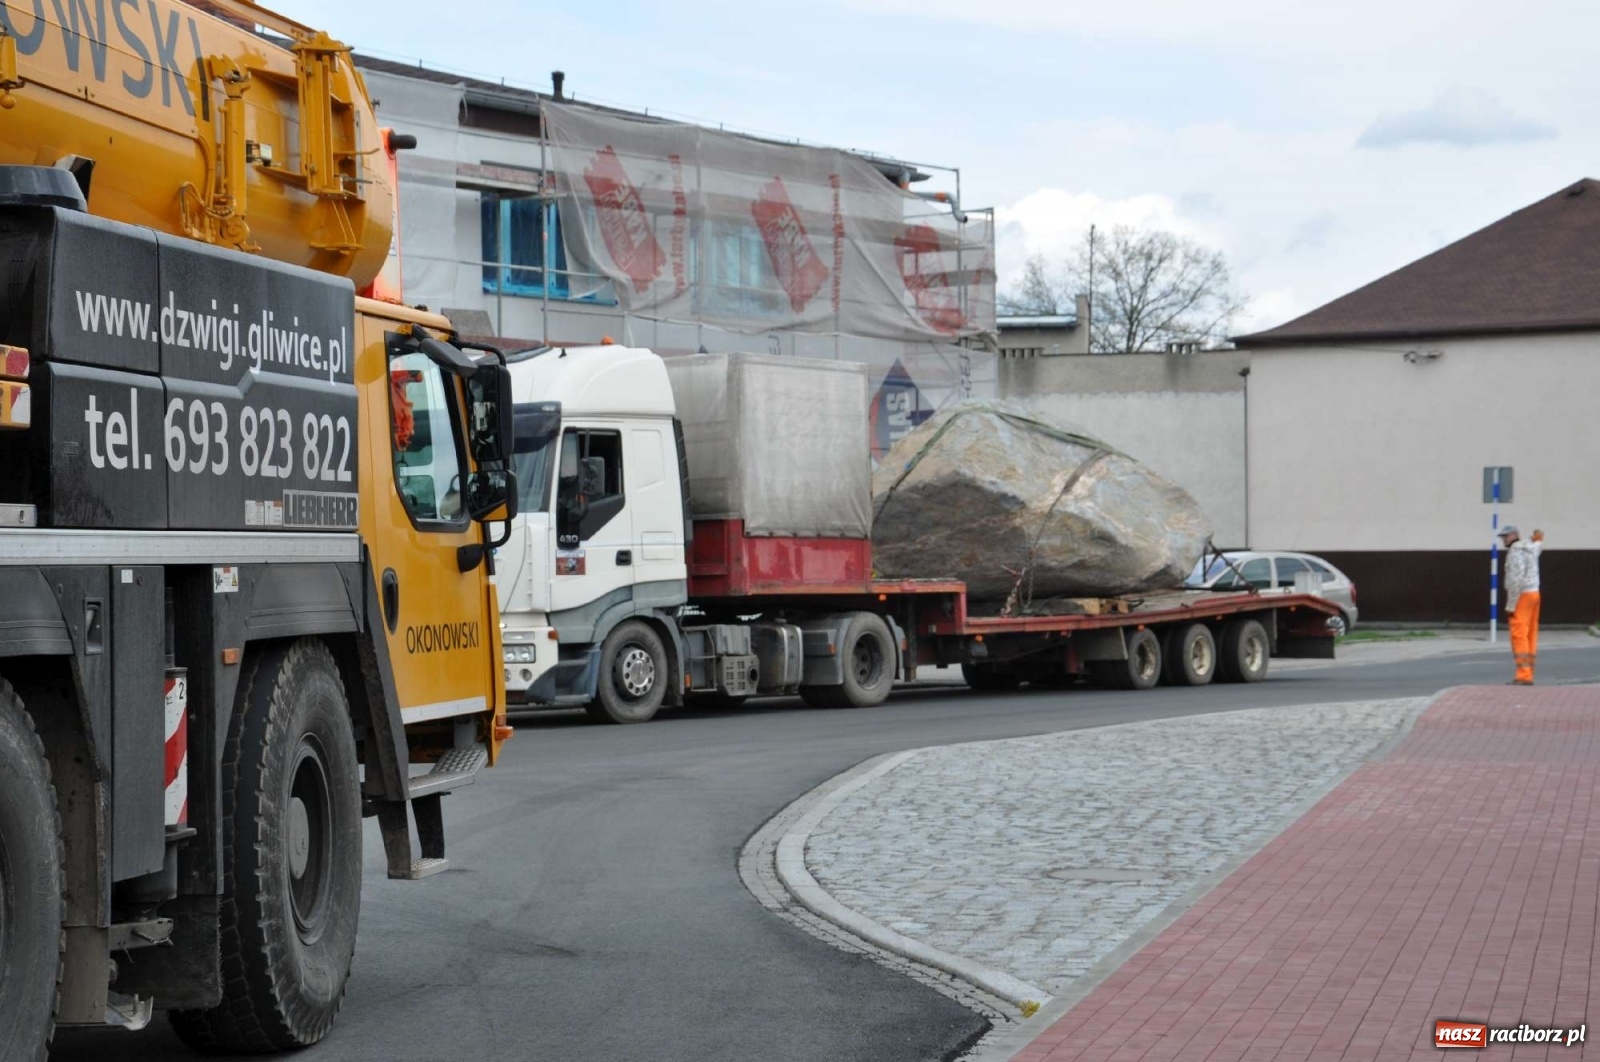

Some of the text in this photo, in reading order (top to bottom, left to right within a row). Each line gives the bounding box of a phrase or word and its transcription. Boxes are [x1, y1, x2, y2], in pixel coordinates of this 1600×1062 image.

[76, 290, 347, 386] www.dzwigi.gliwice.pl
[84, 388, 352, 482] tel. 693 823 822
[284, 493, 358, 526] LIEBHERR
[559, 534, 579, 543] 430
[406, 622, 480, 654] OKONOWSKI
